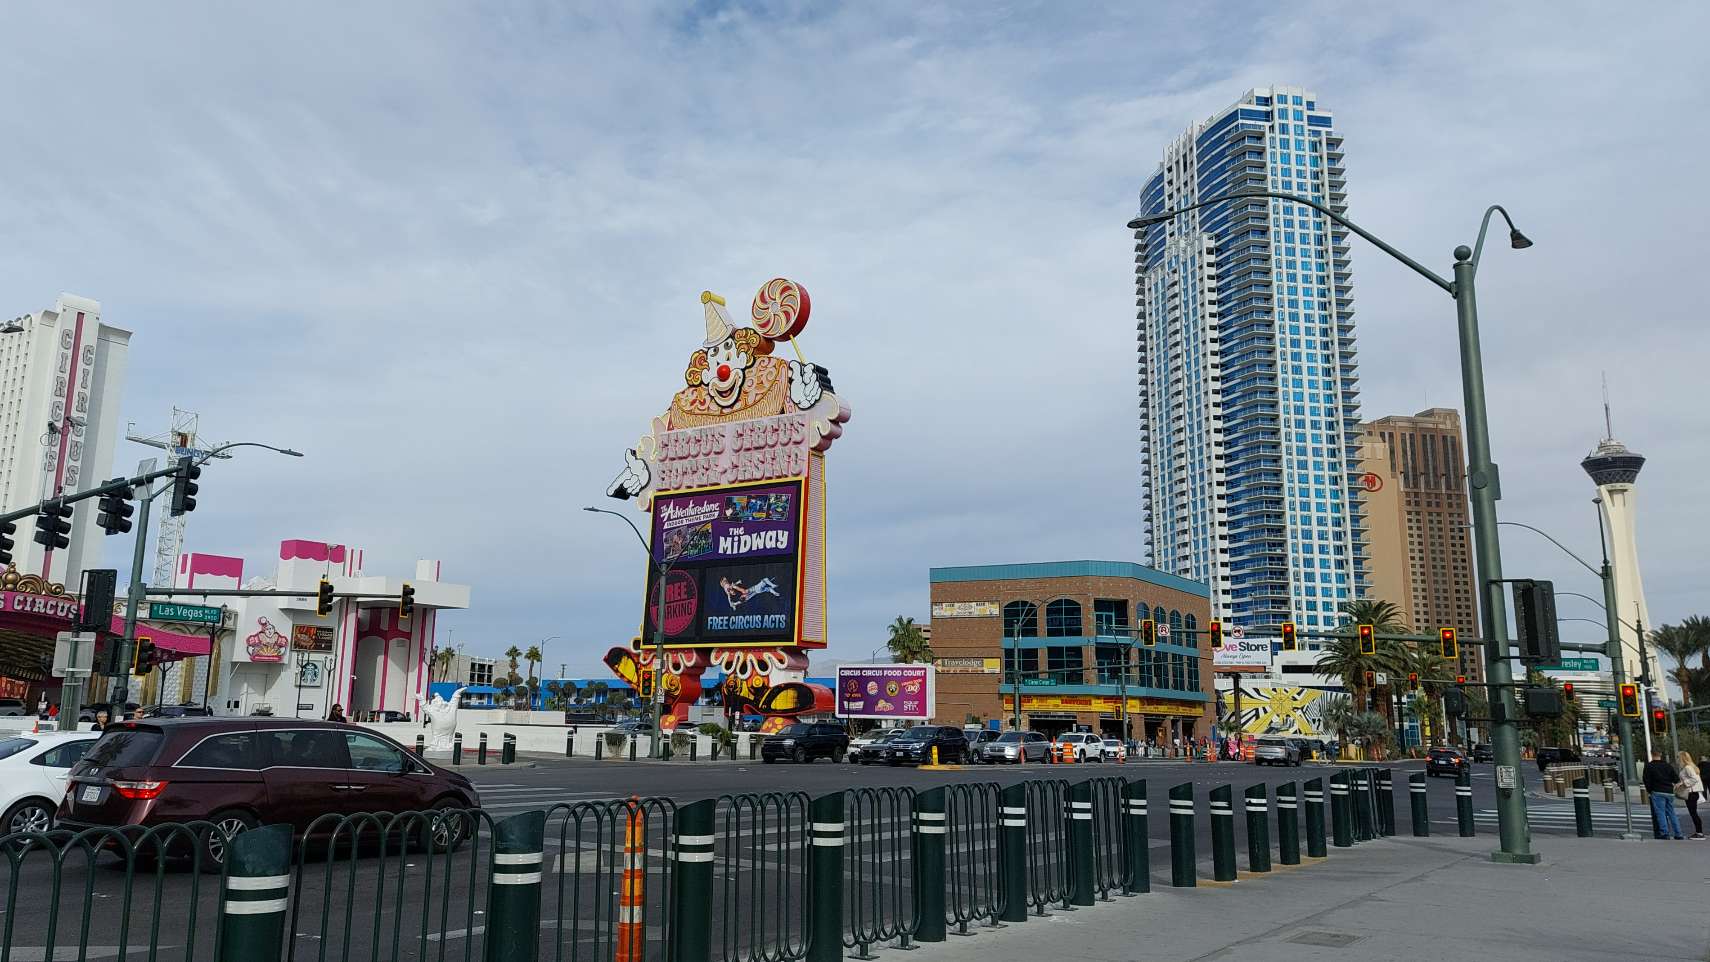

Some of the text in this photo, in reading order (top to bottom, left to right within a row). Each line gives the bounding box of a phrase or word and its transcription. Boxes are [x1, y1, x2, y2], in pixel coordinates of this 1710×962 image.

[661, 499, 721, 521] Adventuredome
[702, 511, 717, 520] PARK
[665, 581, 688, 603] REE
[12, 594, 78, 619] CIRCUS
[158, 604, 203, 620] Las Vegas
[707, 614, 786, 630] FREE CIRCUS ACTS
[1238, 641, 1269, 652] Store
[943, 658, 983, 667] Travelodge
[1561, 659, 1582, 669] resley
[839, 669, 926, 677] CIRCUS CIRCUS FOOD COURT
